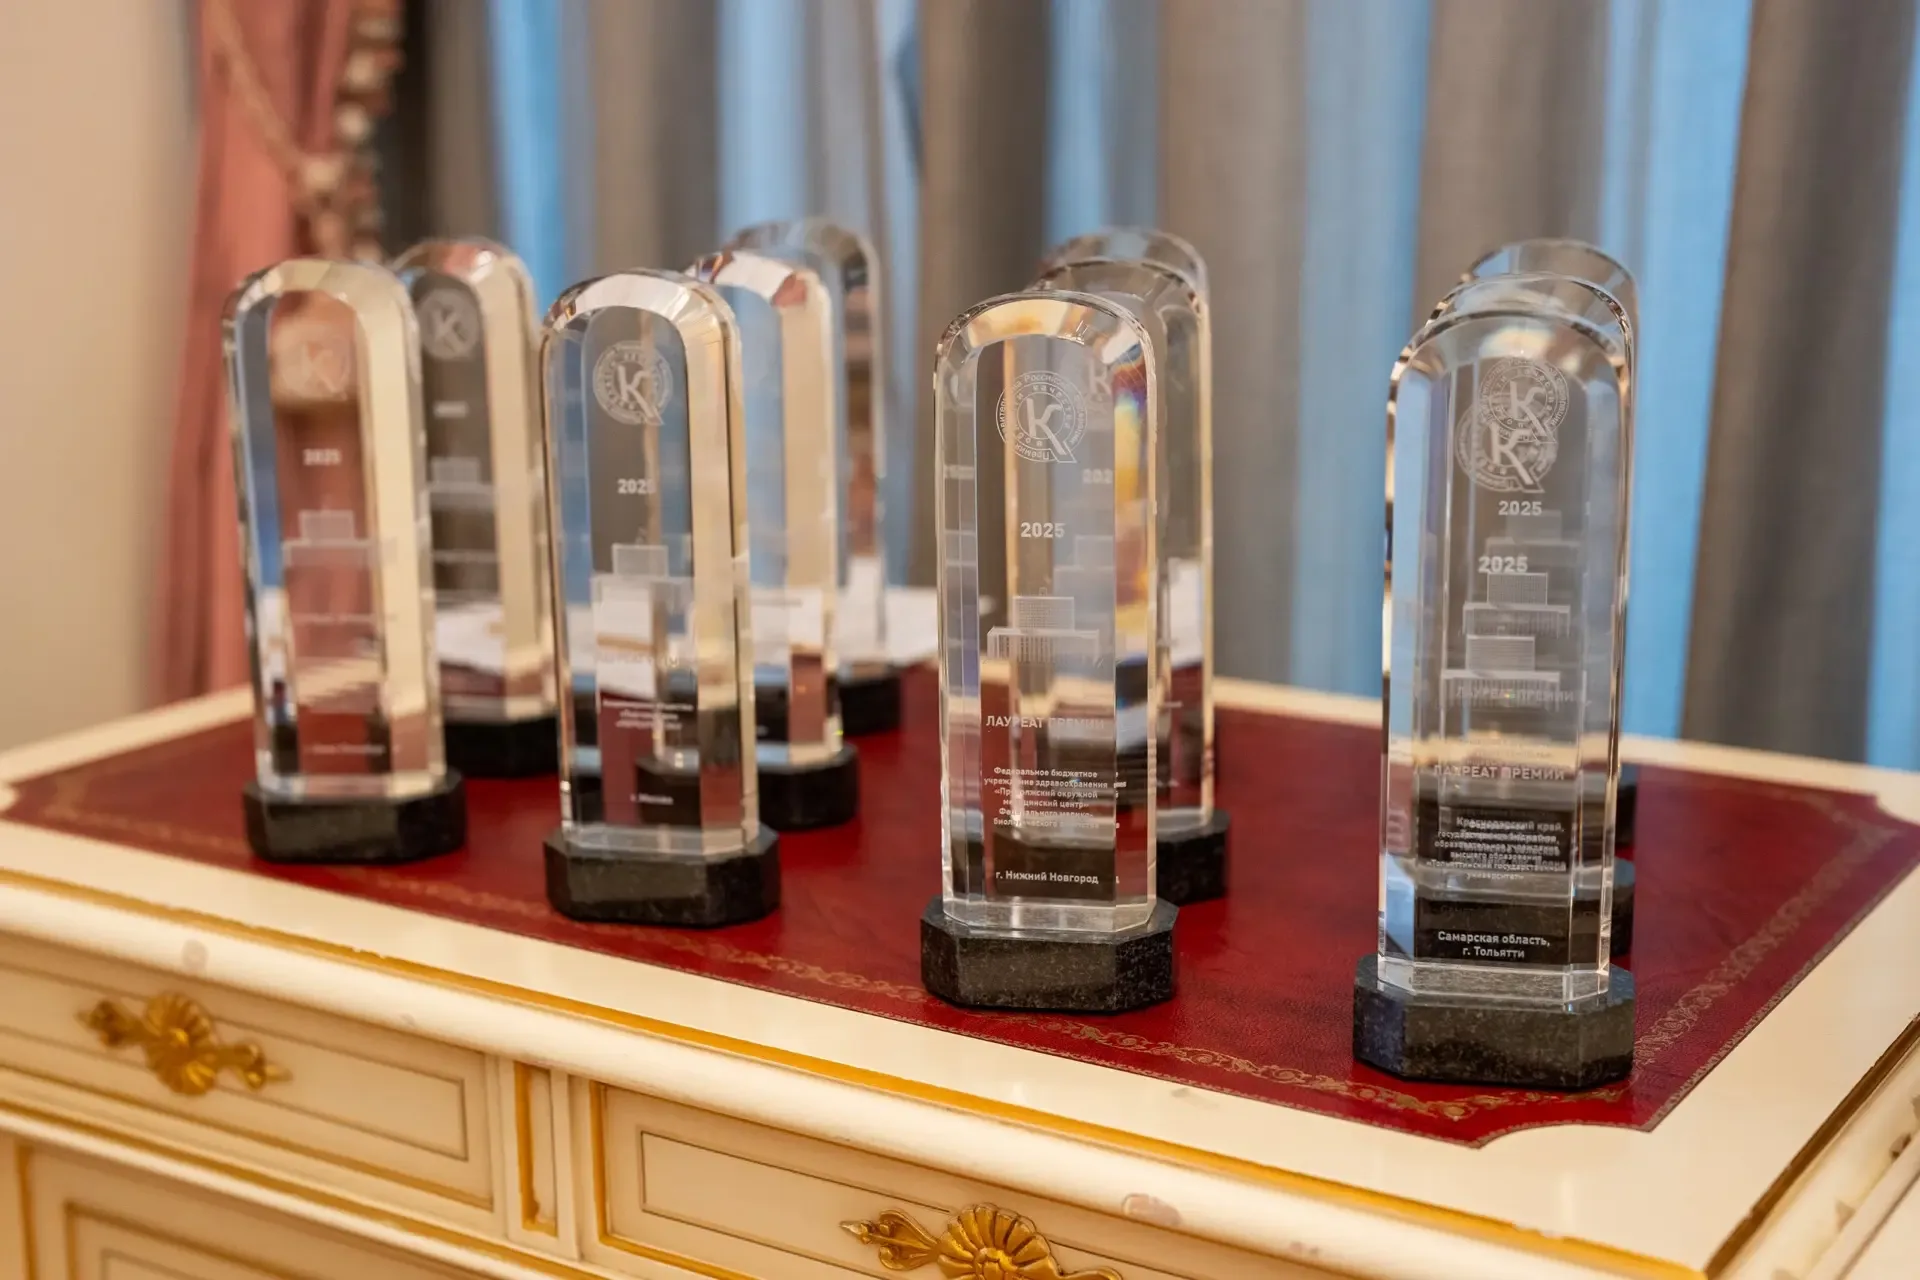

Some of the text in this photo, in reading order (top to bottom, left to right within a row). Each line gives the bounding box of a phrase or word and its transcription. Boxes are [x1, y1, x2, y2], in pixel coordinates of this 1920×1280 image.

[1498, 501, 1543, 515] 2025
[1021, 522, 1066, 538] 2025
[1477, 556, 1528, 573] 2025
[1051, 769, 1098, 778] бюджетное
[1500, 766, 1564, 780] ПРЕМИИ
[1057, 790, 1098, 799] окружной
[1006, 871, 1047, 881] Нижний
[1050, 872, 1099, 884] Новгород
[1438, 931, 1551, 947] Самарская область,
[1462, 946, 1525, 959] г. Тольятти
